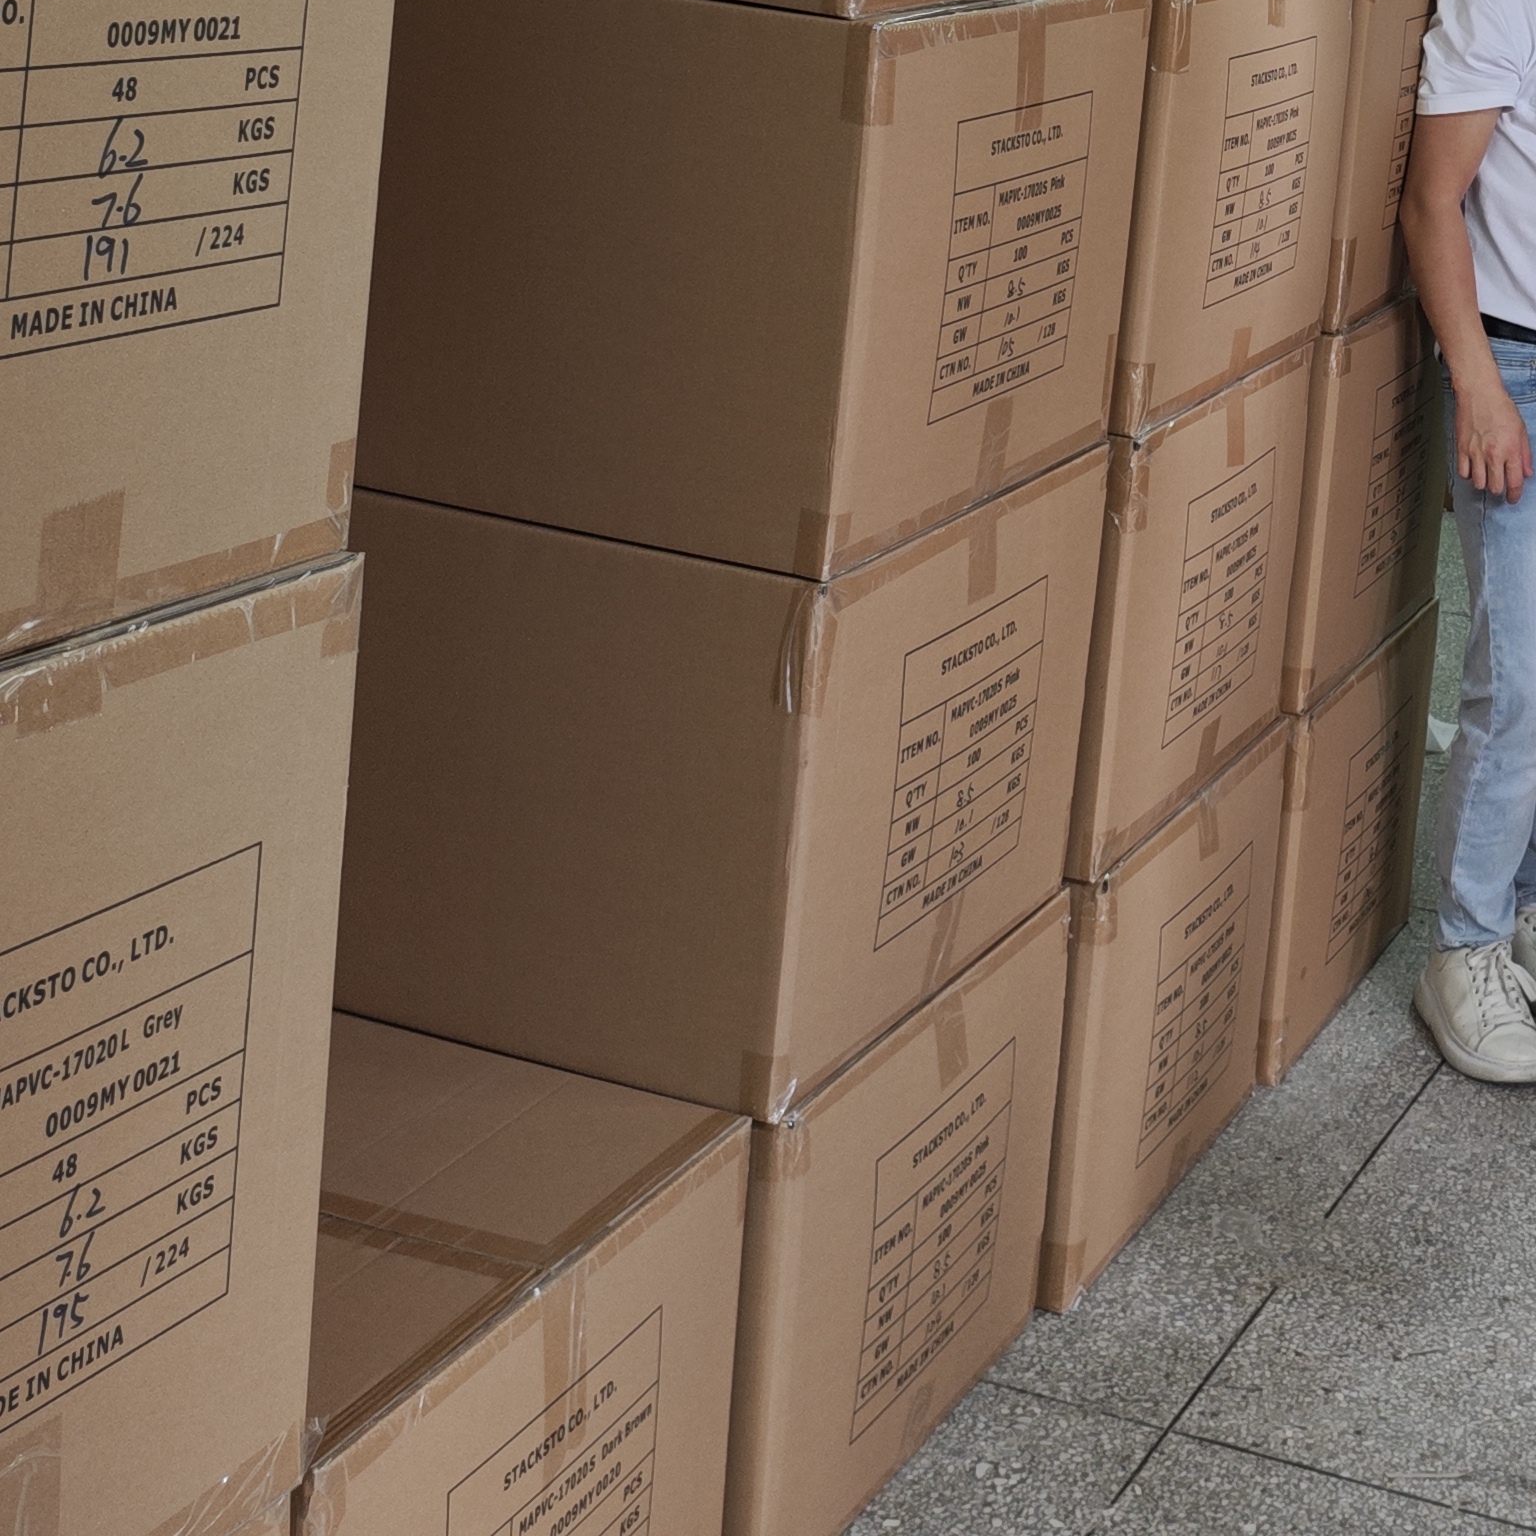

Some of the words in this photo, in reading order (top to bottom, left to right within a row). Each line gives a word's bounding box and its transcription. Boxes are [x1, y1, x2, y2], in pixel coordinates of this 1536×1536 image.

[111, 76, 138, 103] 48
[244, 64, 280, 91] PCS
[97, 116, 149, 179] 6.2
[237, 116, 275, 143] KGS
[991, 132, 1031, 156] STACKSTO
[1047, 124, 1064, 142] LTD.
[232, 167, 271, 196] KGS
[1050, 174, 1066, 192] Pink
[90, 172, 144, 230] 7.6
[953, 215, 975, 235] ITEM
[972, 211, 991, 229] NO.
[83, 234, 129, 282] 191
[1013, 244, 1028, 263] 100
[1060, 228, 1074, 246] PCS
[958, 260, 978, 284] Q'TY
[1056, 258, 1071, 276] KGS
[10, 304, 74, 340] MADE
[78, 298, 105, 328] IN
[110, 286, 177, 321] CHINA
[957, 294, 972, 312] NW
[1052, 288, 1067, 306] KGS
[952, 326, 968, 345] GW
[939, 361, 957, 380] CTN
[956, 356, 971, 373] NO.
[972, 375, 996, 397] MADE
[995, 371, 1006, 388] IN
[1006, 360, 1030, 383] CHINA
[81, 950, 125, 984] CO.,
[130, 924, 175, 963] LTD.
[142, 1003, 184, 1039] Grey
[51, 1152, 79, 1184] 48
[185, 1075, 222, 1115] PCS
[179, 1125, 219, 1166] KGS
[58, 1182, 107, 1239] 6.2
[175, 1173, 216, 1215] KGS
[54, 1230, 96, 1288] 7.6
[37, 1291, 90, 1357] 195
[24, 1365, 52, 1403] IN
[56, 1323, 125, 1382] CHINA
[502, 1424, 566, 1492] STACKSTO
[567, 1407, 592, 1434] CO.,
[592, 1379, 618, 1412] LTD.
[518, 1453, 597, 1536] MAPVC-17020S
[600, 1429, 624, 1461] Dark
[624, 1402, 653, 1439] Brown
[622, 1470, 644, 1503] PCS
[618, 1504, 641, 1536] KGS
